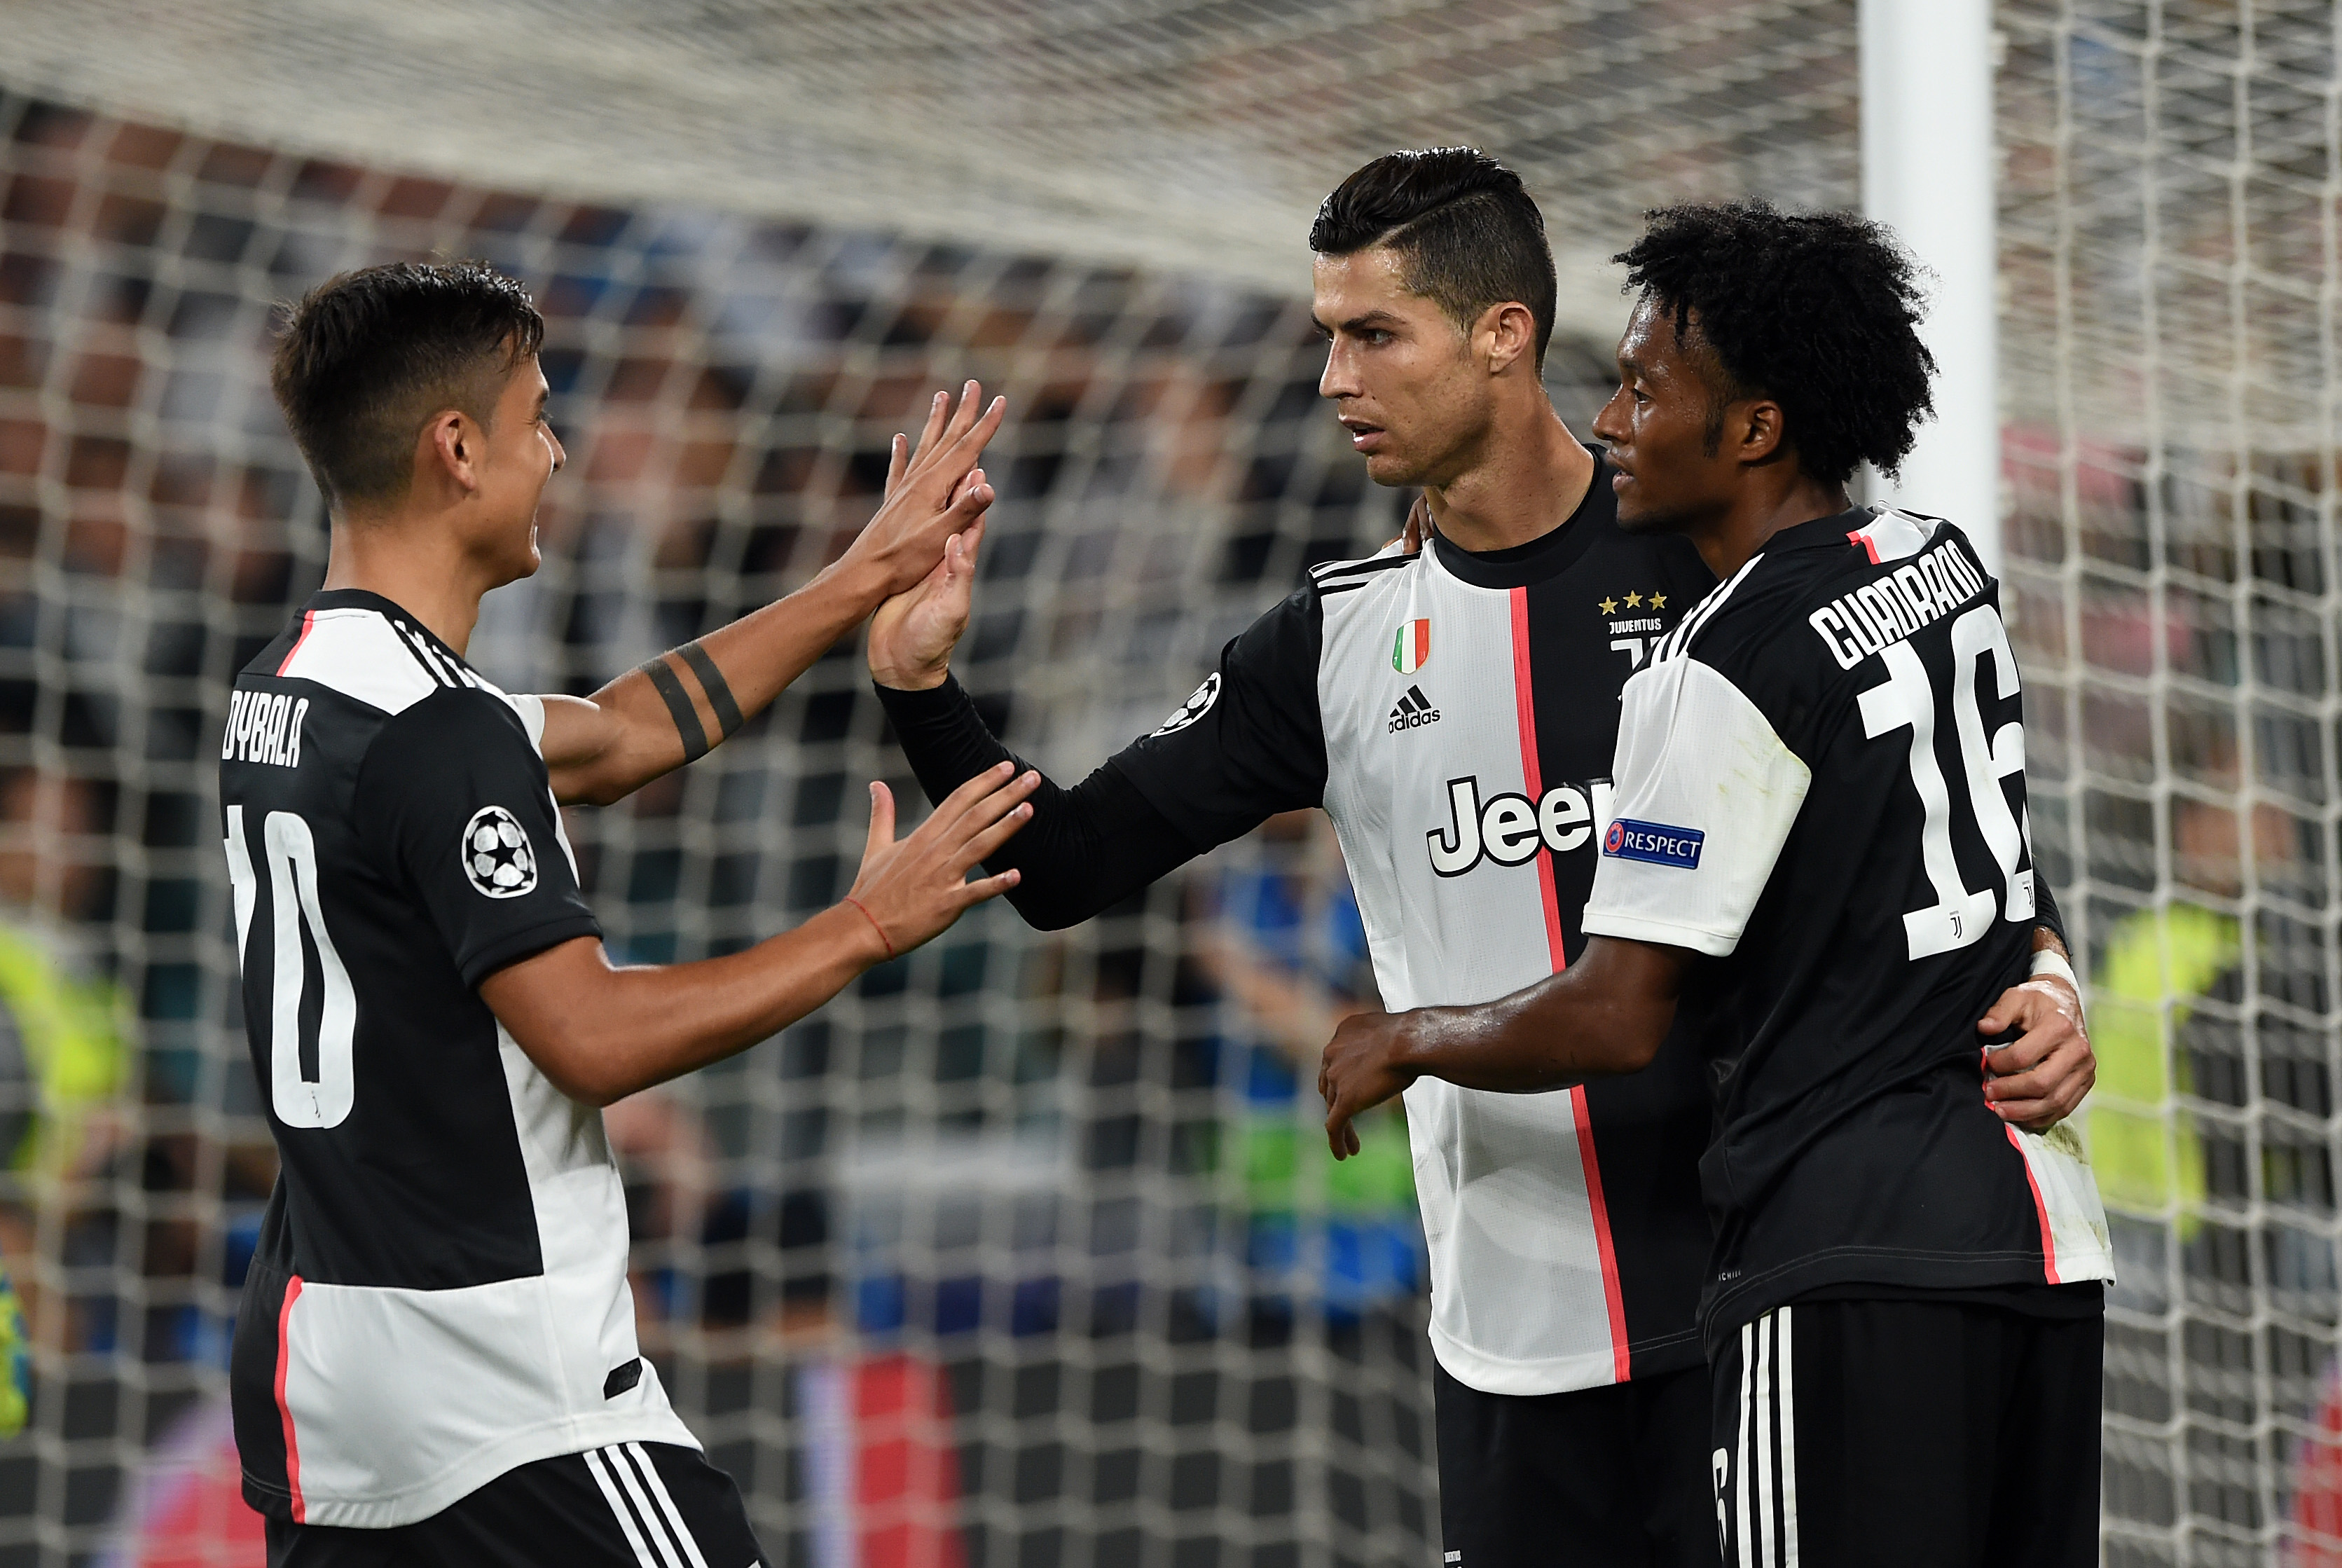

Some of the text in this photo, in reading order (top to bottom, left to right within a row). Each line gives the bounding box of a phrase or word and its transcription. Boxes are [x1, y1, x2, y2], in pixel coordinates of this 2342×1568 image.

[1609, 618, 1662, 634] JUVENTUS
[1808, 539, 1983, 670] CUADRADO
[222, 690, 309, 768] DYBALA
[1389, 710, 1440, 734] adidas
[1857, 604, 2035, 961] 16
[1625, 832, 1700, 858] RESPECT
